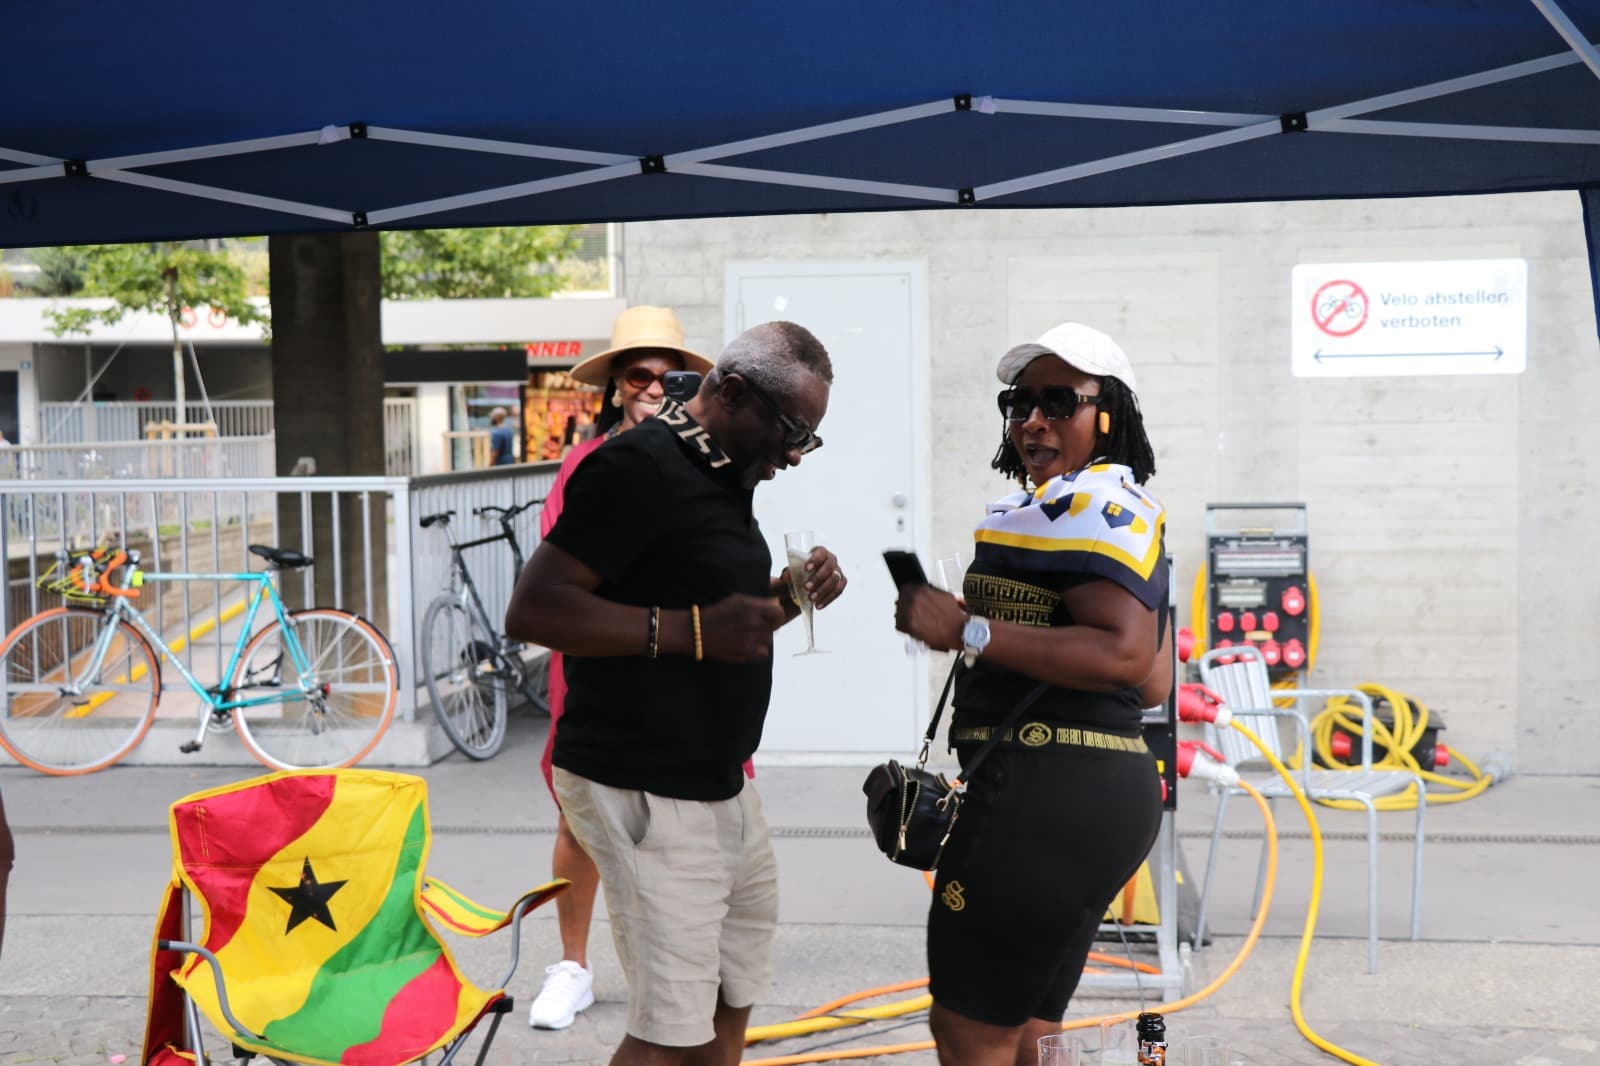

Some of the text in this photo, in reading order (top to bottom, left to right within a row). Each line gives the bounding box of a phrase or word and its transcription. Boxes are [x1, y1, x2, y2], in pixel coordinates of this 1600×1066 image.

[1380, 289, 1510, 306] Velo abstellen
[1380, 314, 1462, 329] verboten
[525, 341, 582, 358] NNER
